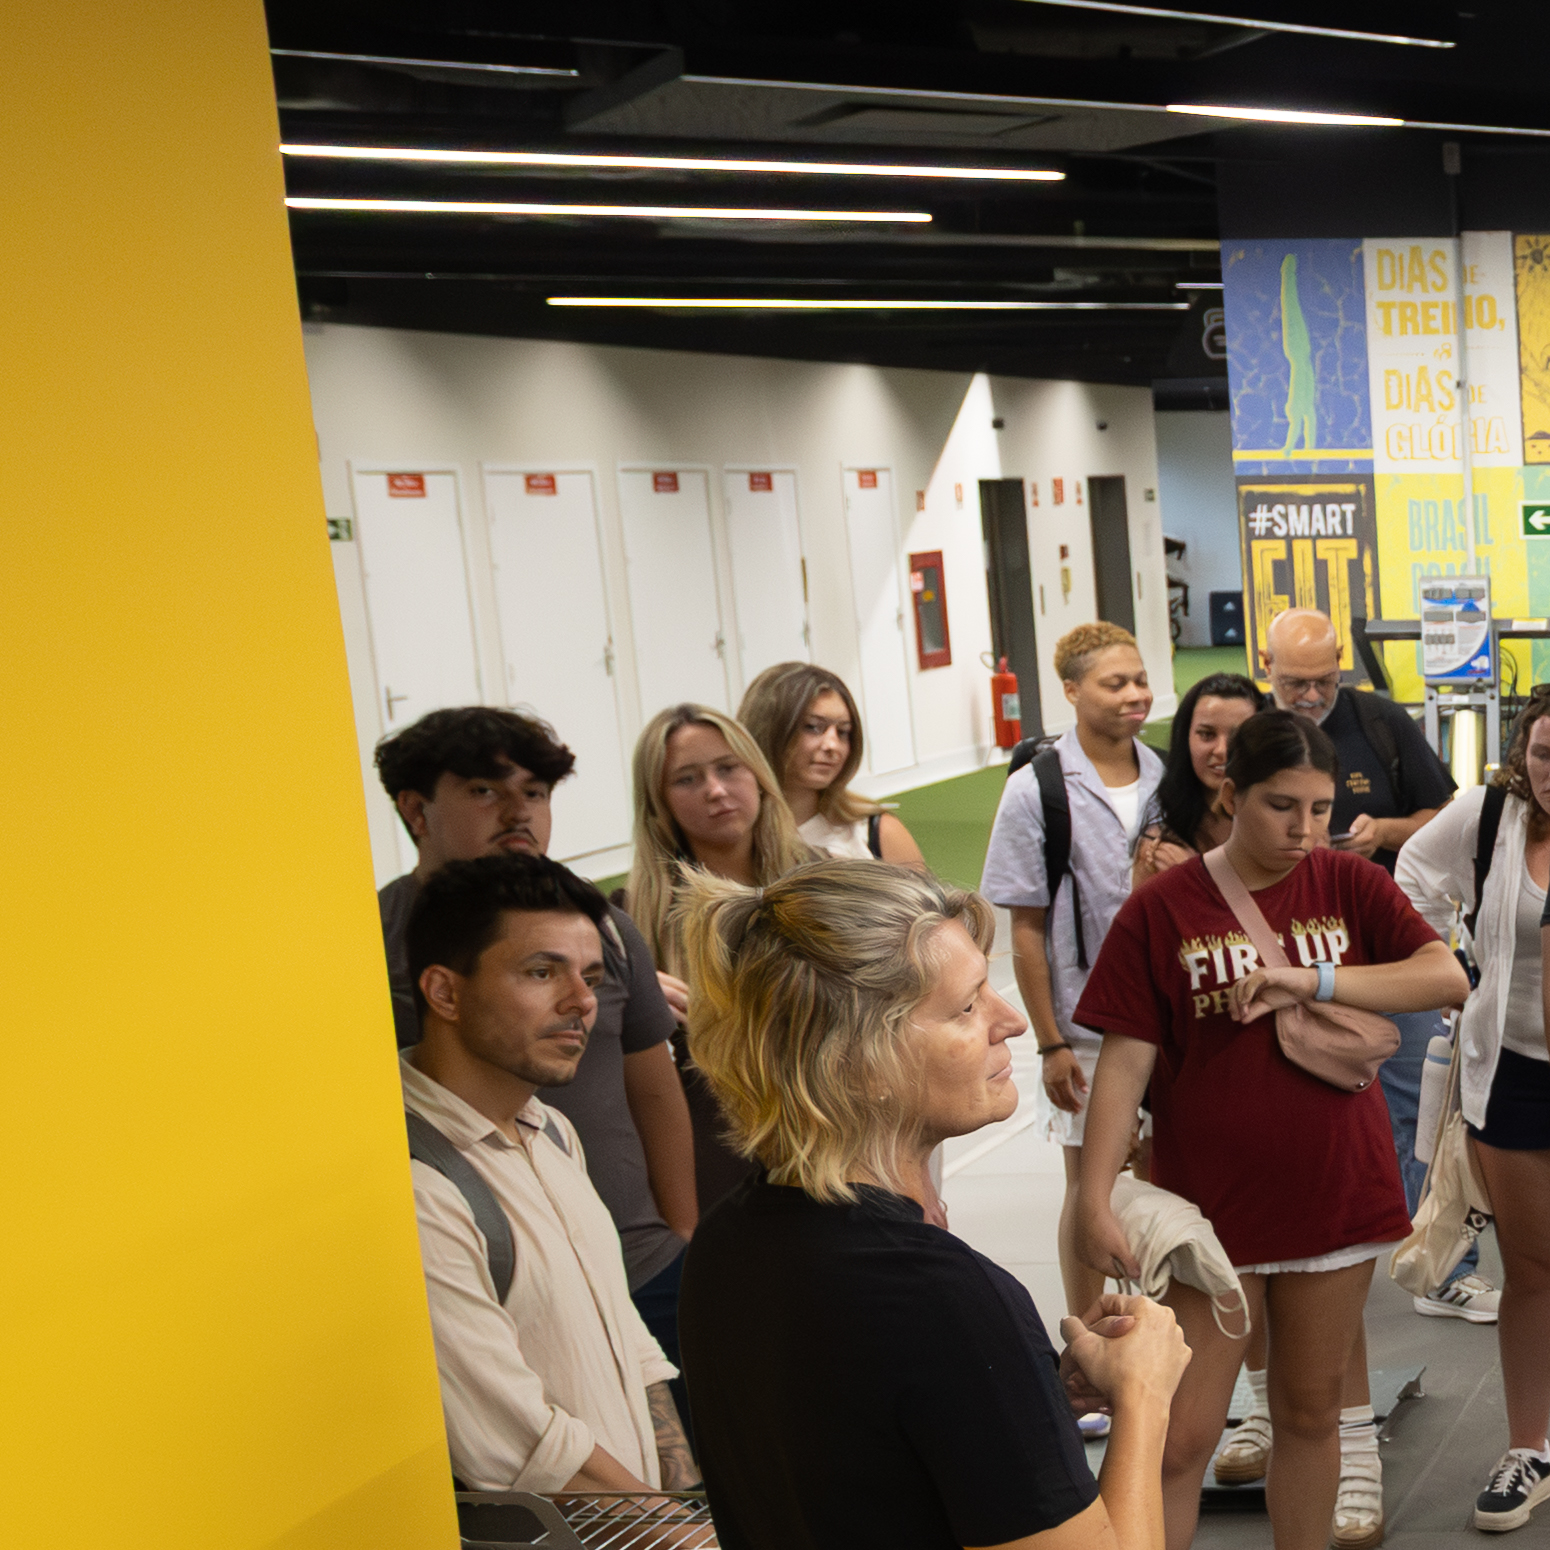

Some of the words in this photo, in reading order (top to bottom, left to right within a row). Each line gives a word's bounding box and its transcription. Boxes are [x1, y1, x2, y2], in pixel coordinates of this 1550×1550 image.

[1376, 245, 1449, 294] DIAS
[1384, 365, 1456, 413] DIAS
[1248, 504, 1357, 537] #SMART
[1291, 916, 1350, 967] UP
